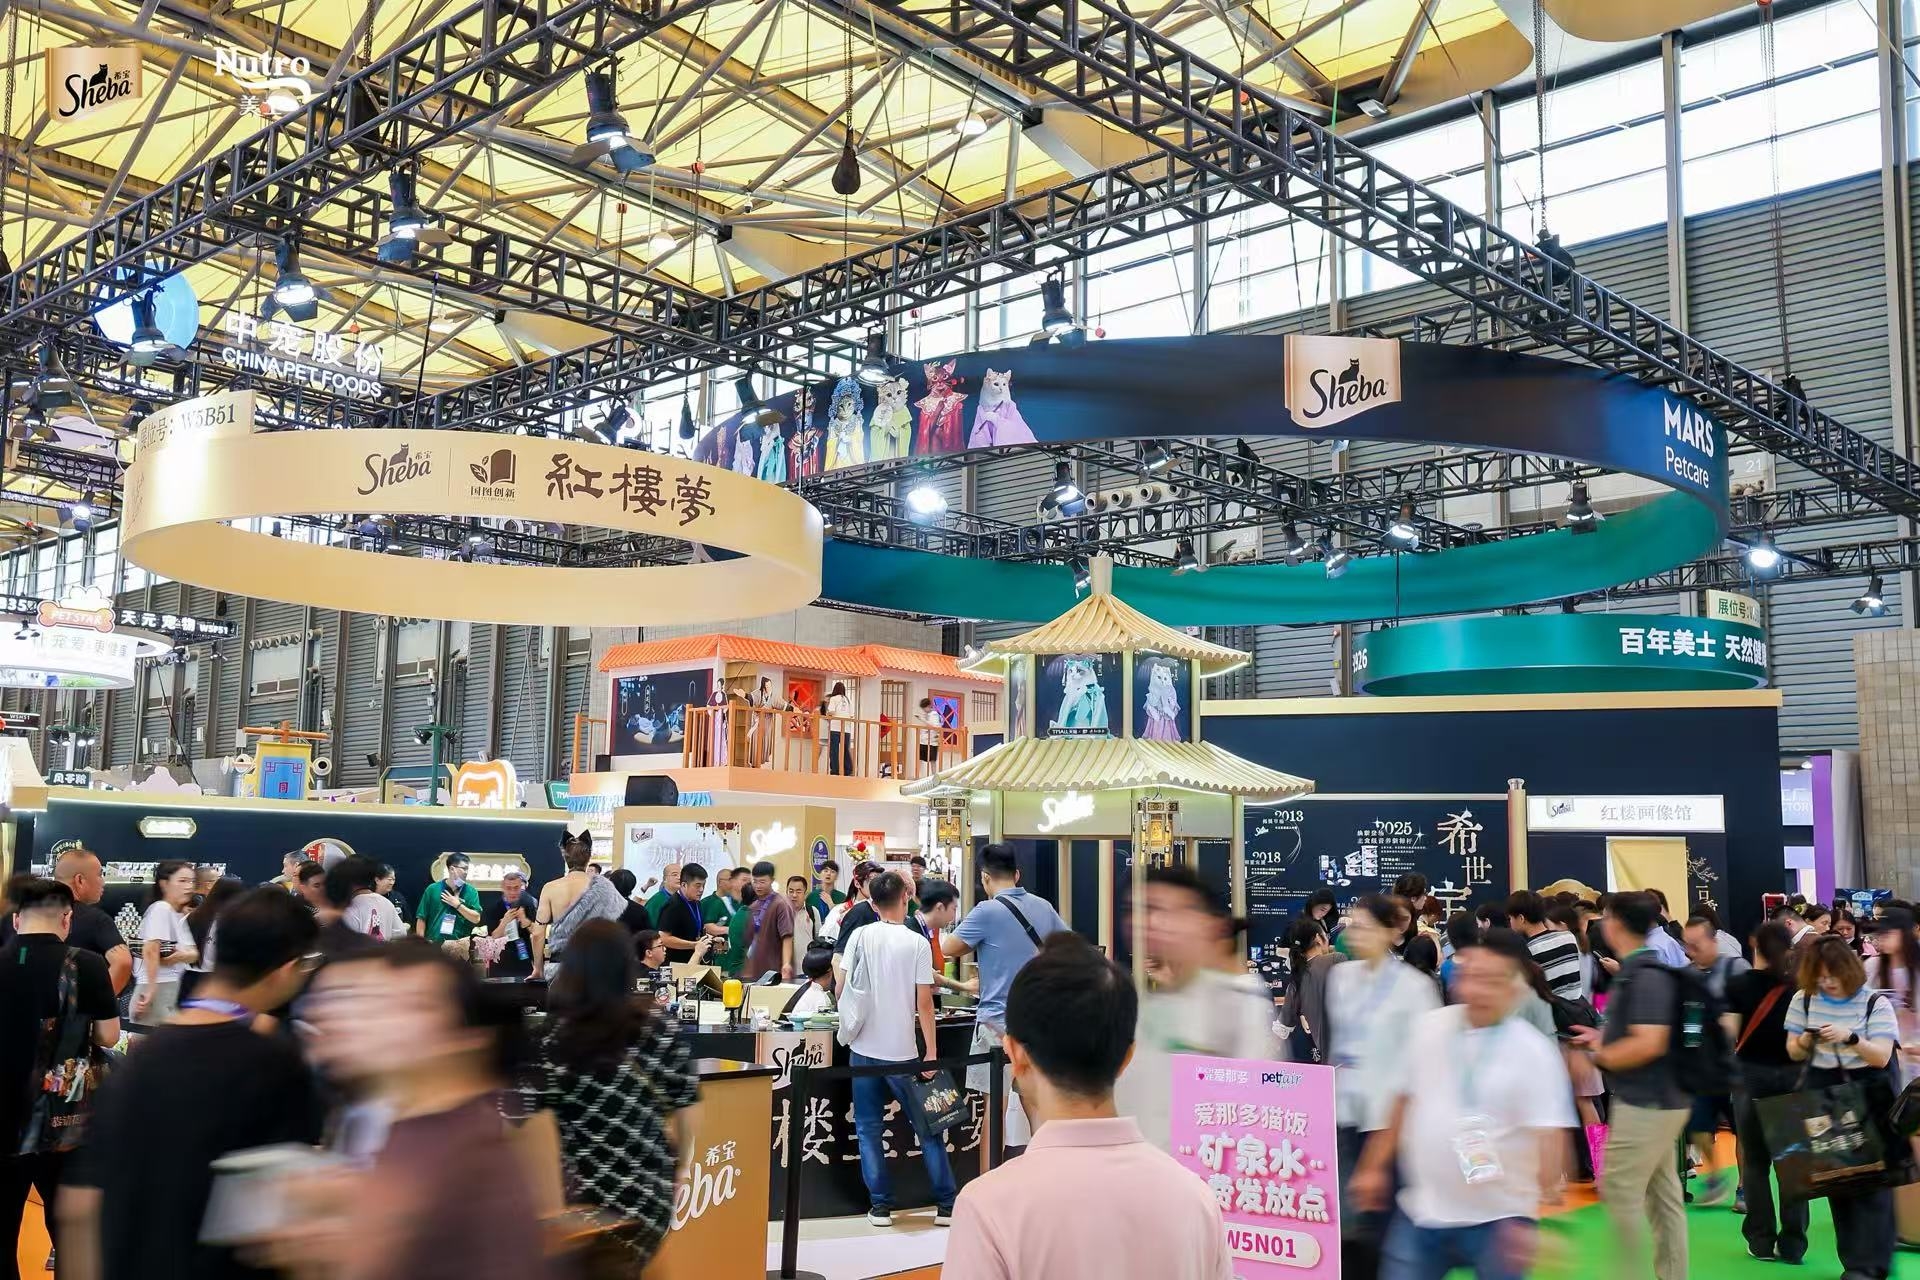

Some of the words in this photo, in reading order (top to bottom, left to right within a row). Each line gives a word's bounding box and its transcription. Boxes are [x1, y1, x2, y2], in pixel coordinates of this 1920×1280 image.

[224, 311, 385, 376] 中宠股份
[221, 346, 278, 376] CHINA
[282, 357, 321, 382] PET
[320, 371, 383, 398] FOODS
[1302, 368, 1388, 418] Sheba
[1663, 397, 1714, 458] MARS
[357, 453, 432, 495] Sheba
[1665, 445, 1710, 489] Petcare
[470, 486, 515, 498] 国图创新
[545, 452, 716, 527] 紅樓夢
[120, 610, 196, 632] 天元宠物
[1618, 627, 1717, 659] 百年美士
[1274, 810, 1304, 822] 2013
[1375, 821, 1412, 835] 2025
[1600, 805, 1693, 822] 红楼画像馆
[1252, 851, 1281, 864] 2018
[1194, 1102, 1310, 1137] 爱那多猫饭
[704, 1140, 737, 1167] 希宝
